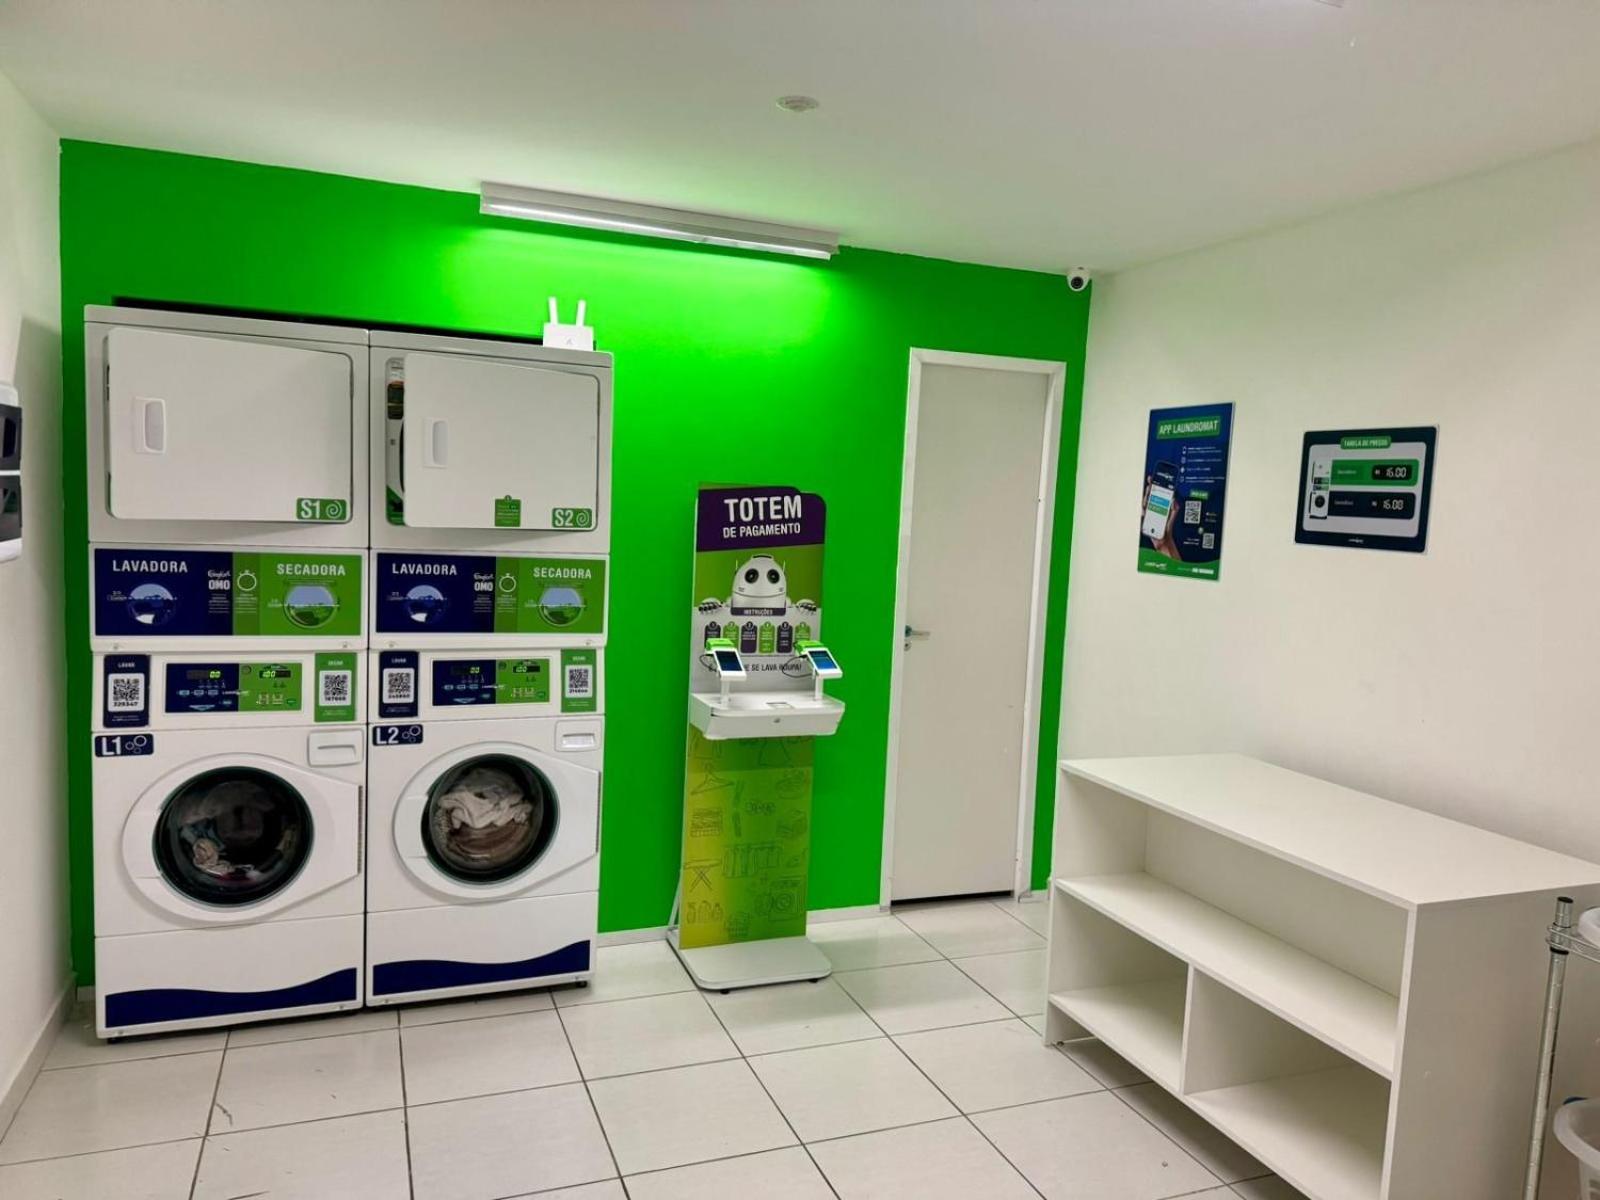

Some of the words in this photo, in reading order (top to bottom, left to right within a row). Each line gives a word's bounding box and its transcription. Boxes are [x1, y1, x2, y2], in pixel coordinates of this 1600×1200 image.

[1159, 424, 1172, 435] APP
[1173, 420, 1219, 434] LAUNDROMAT
[300, 500, 321, 518] S1
[723, 494, 802, 523] TOTEM
[554, 509, 574, 527] S2
[722, 527, 737, 539] DE
[739, 522, 802, 538] PAGAMENTO
[112, 560, 188, 573] LAVADORA
[276, 563, 346, 577] SECADORA
[391, 563, 457, 577] LAVADORA
[533, 567, 592, 579] SECADORA
[208, 579, 231, 591] OMO
[474, 581, 494, 591] OMO
[751, 664, 760, 672] SE
[761, 664, 777, 672] LAVA
[375, 726, 399, 744] L2
[100, 737, 122, 755] L1
